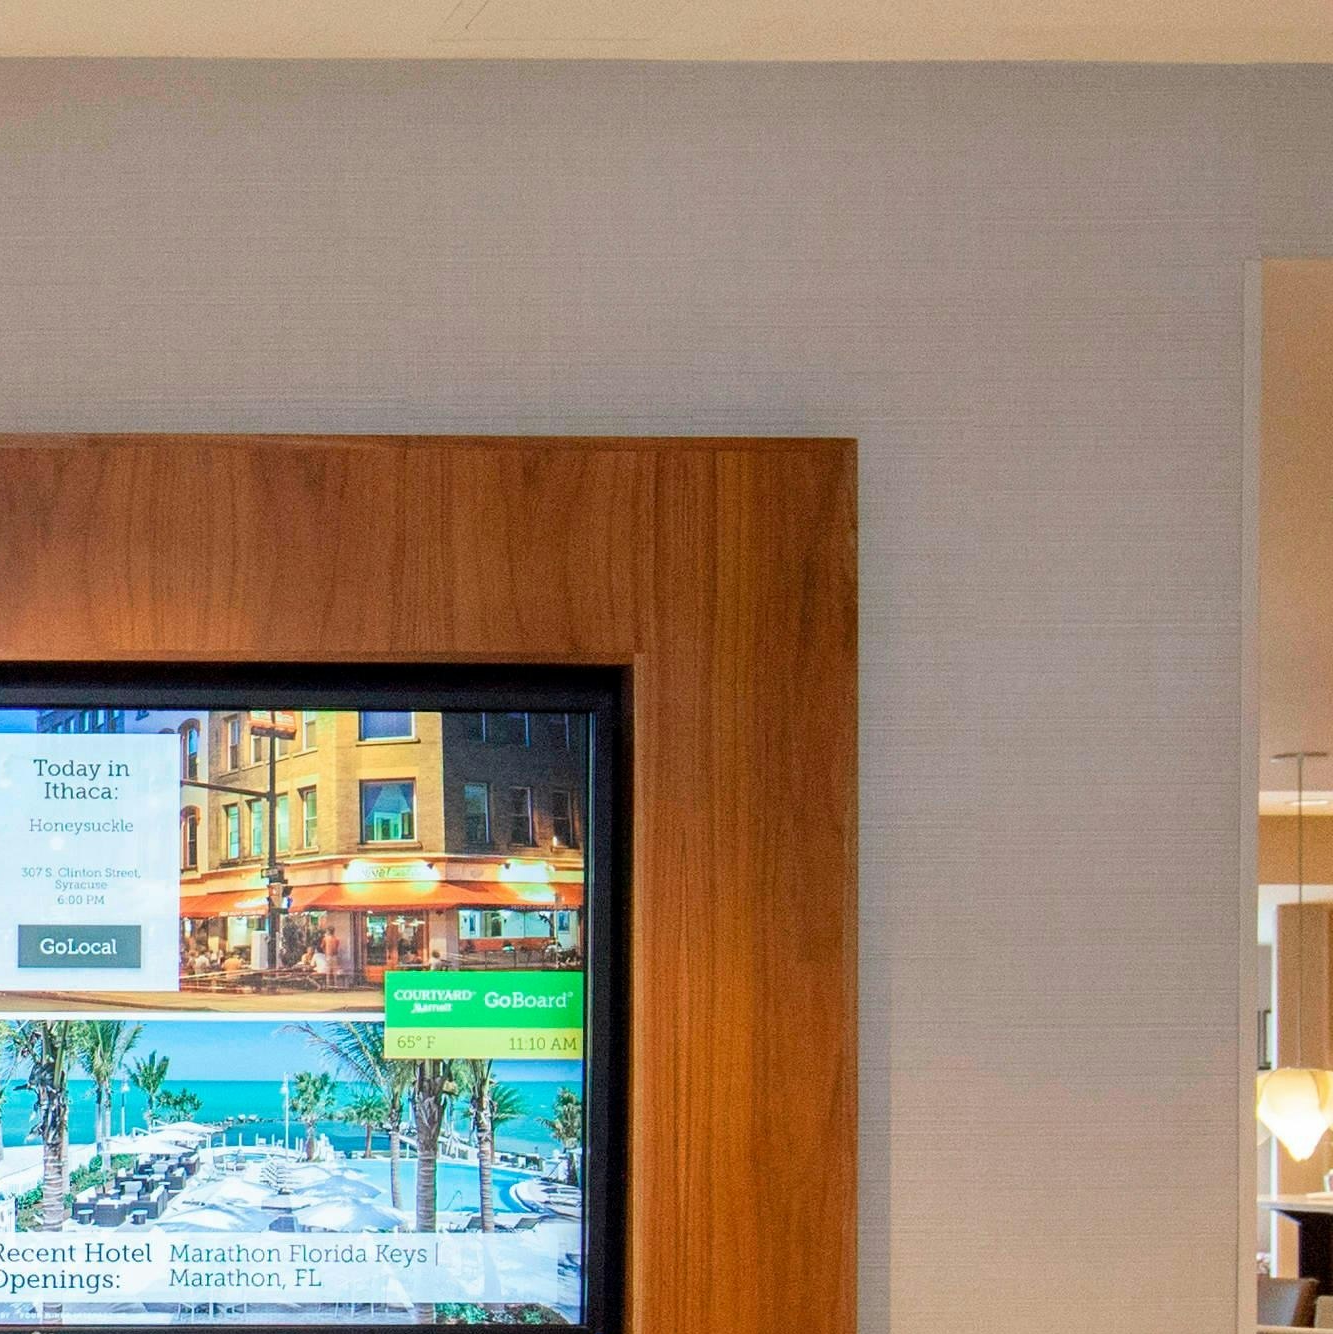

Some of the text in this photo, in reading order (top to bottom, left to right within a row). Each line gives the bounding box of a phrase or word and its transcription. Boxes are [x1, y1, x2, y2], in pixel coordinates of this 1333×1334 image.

[33, 759, 130, 782] Today in
[44, 781, 119, 800] Ithaca:
[28, 818, 134, 835] Honeysuckle
[21, 867, 43, 878] 307
[57, 867, 102, 878] Clinton
[104, 867, 142, 879] Street,
[54, 879, 108, 891] Syracuse
[56, 895, 106, 905] 6:00 PM
[39, 938, 118, 955] GoLocal
[393, 989, 475, 1001] COURTYARD
[426, 1036, 437, 1050] F
[508, 1037, 546, 1051] 11:10
[549, 1037, 578, 1051] AM
[84, 1242, 153, 1263] Hotel
[168, 1243, 282, 1263] Marathon
[288, 1243, 368, 1263] Florida
[375, 1244, 428, 1268] Keys
[168, 1267, 323, 1290] Marathon, FL
